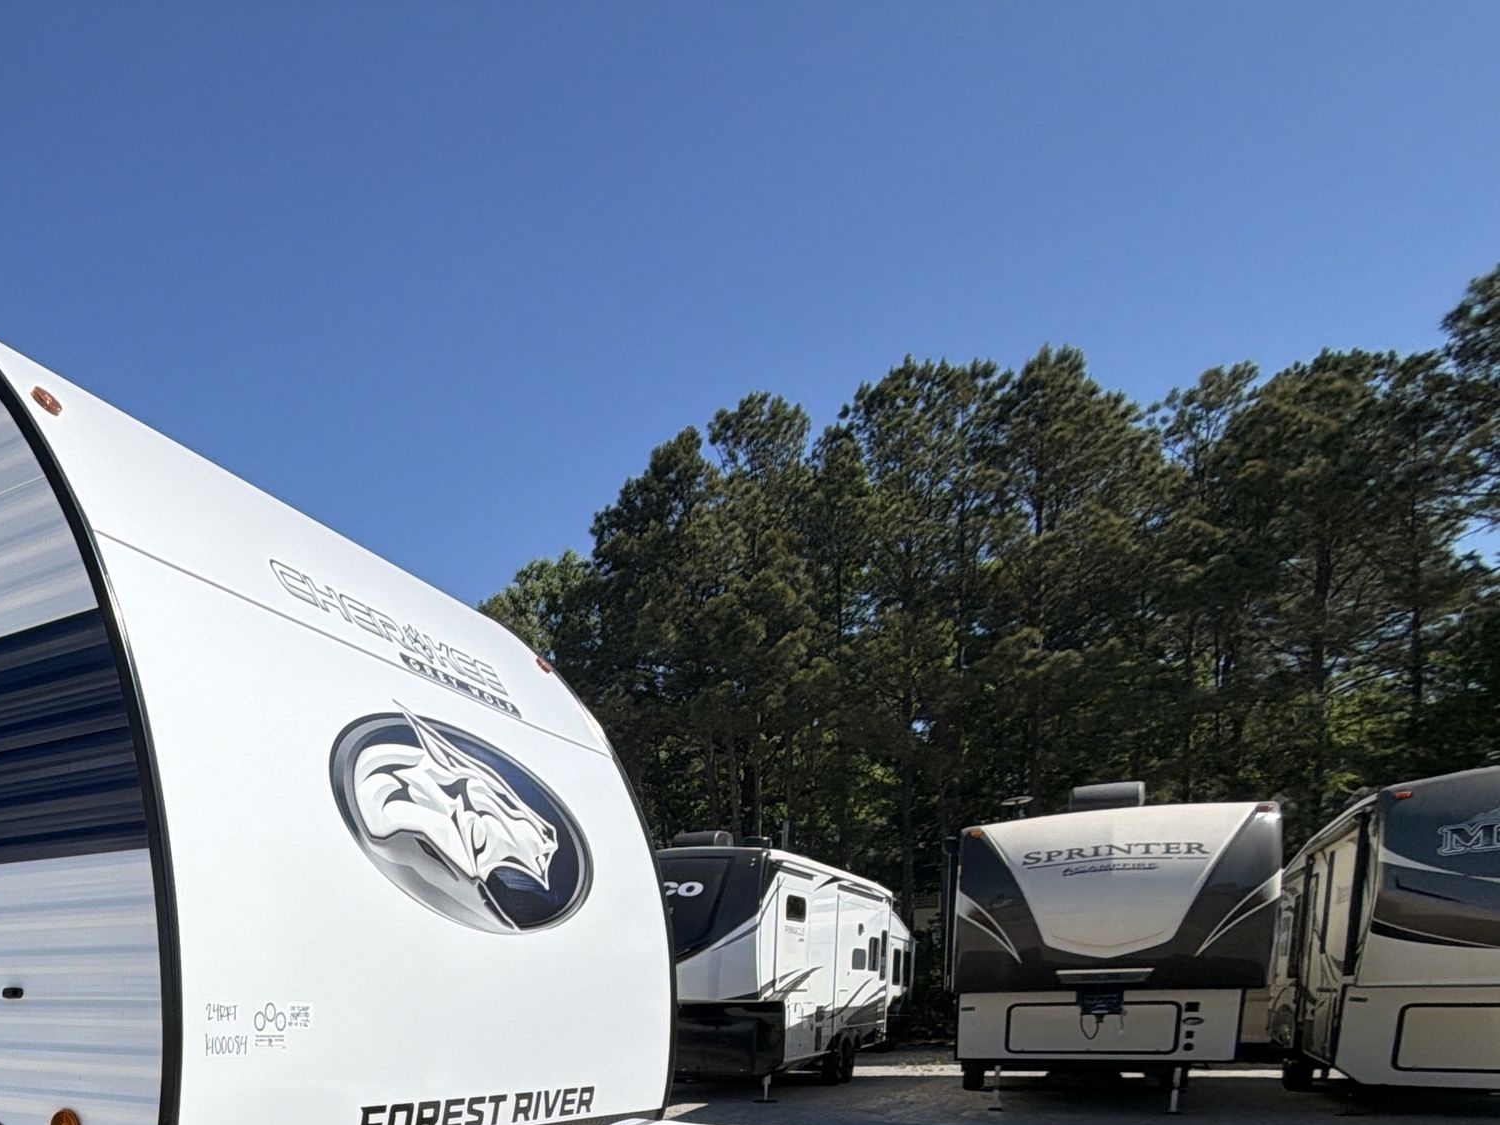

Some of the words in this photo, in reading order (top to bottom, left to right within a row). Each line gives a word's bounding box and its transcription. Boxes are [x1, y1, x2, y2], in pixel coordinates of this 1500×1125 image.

[408, 656, 458, 689] GREY
[467, 686, 514, 713] WOLF
[1022, 842, 1210, 866] SPRINTER
[512, 1086, 595, 1124] RIVER
